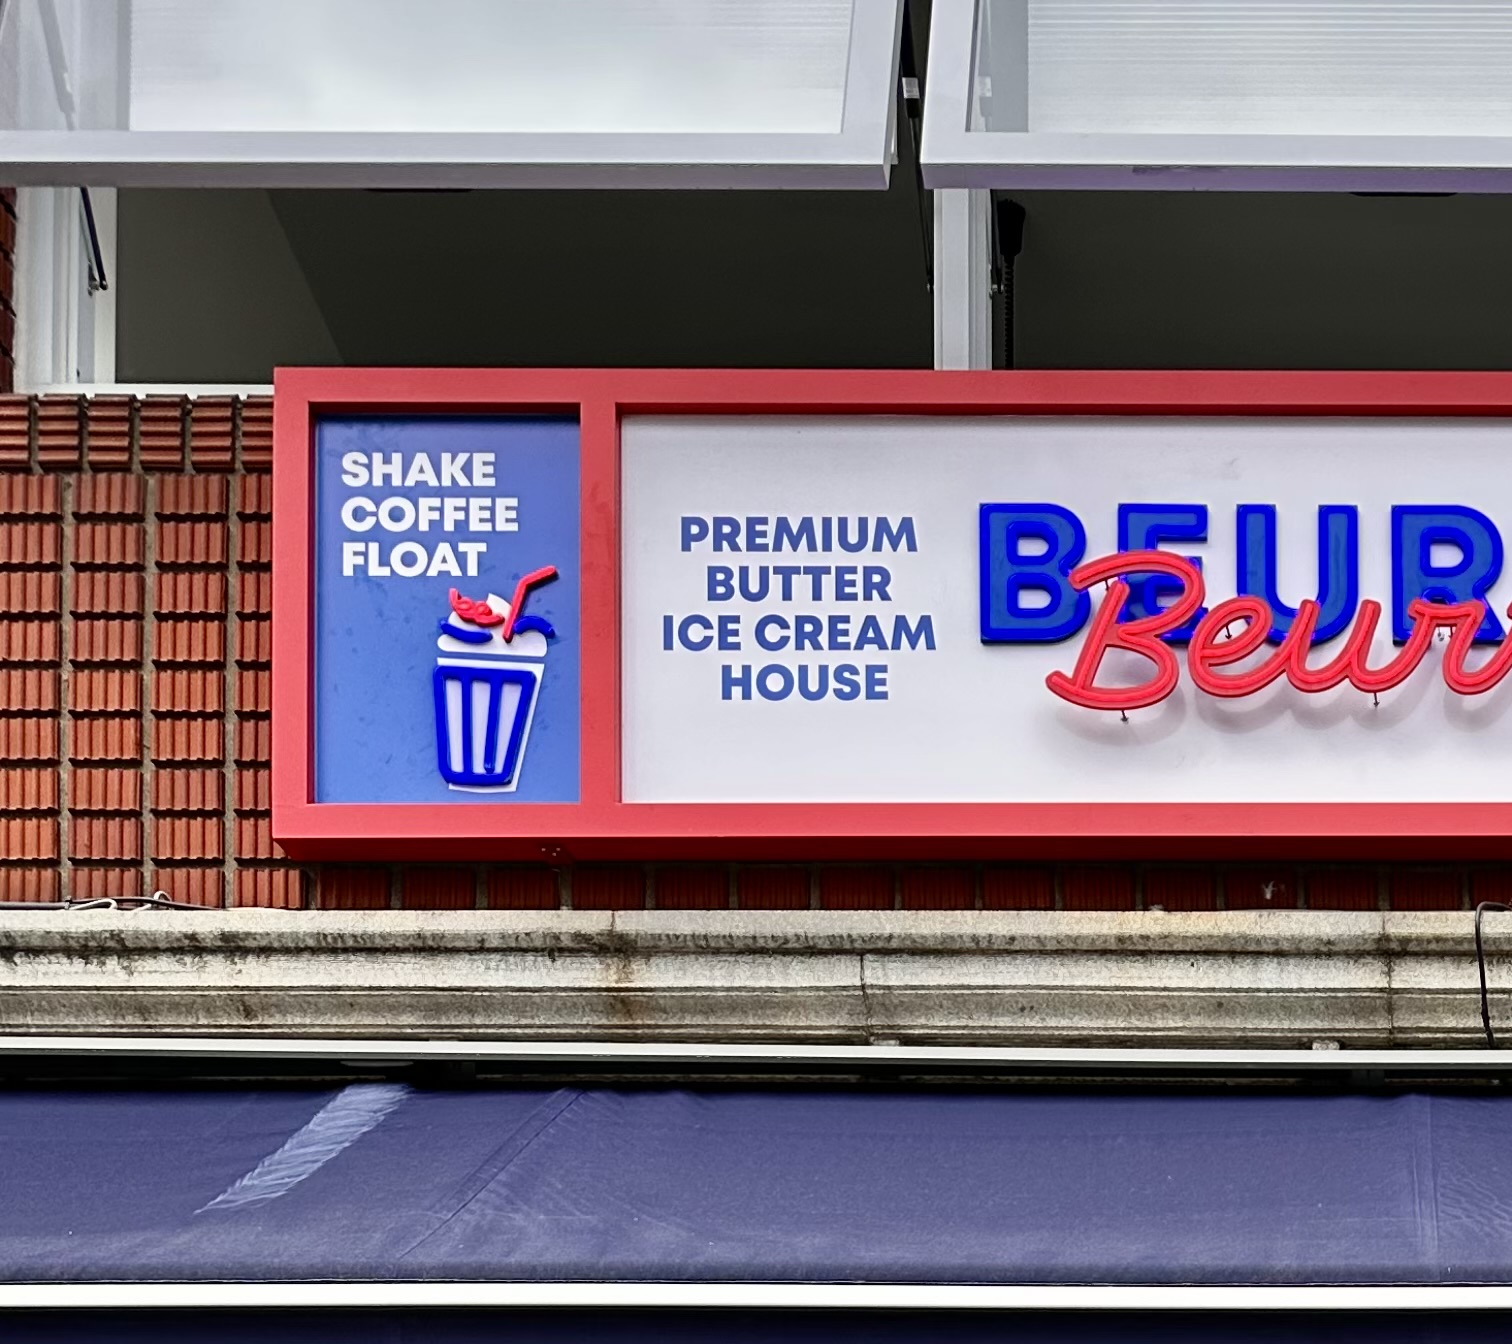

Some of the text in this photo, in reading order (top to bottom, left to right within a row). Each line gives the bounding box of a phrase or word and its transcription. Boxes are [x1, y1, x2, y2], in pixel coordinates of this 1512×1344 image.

[341, 451, 496, 488] SHAKE
[341, 496, 518, 532] COFFEE
[681, 516, 917, 553] PREMIUM
[342, 541, 487, 577] FLOAT
[707, 565, 892, 602] BUTTER
[663, 614, 935, 651] ICE CREAM
[722, 663, 889, 701] HOUSE
